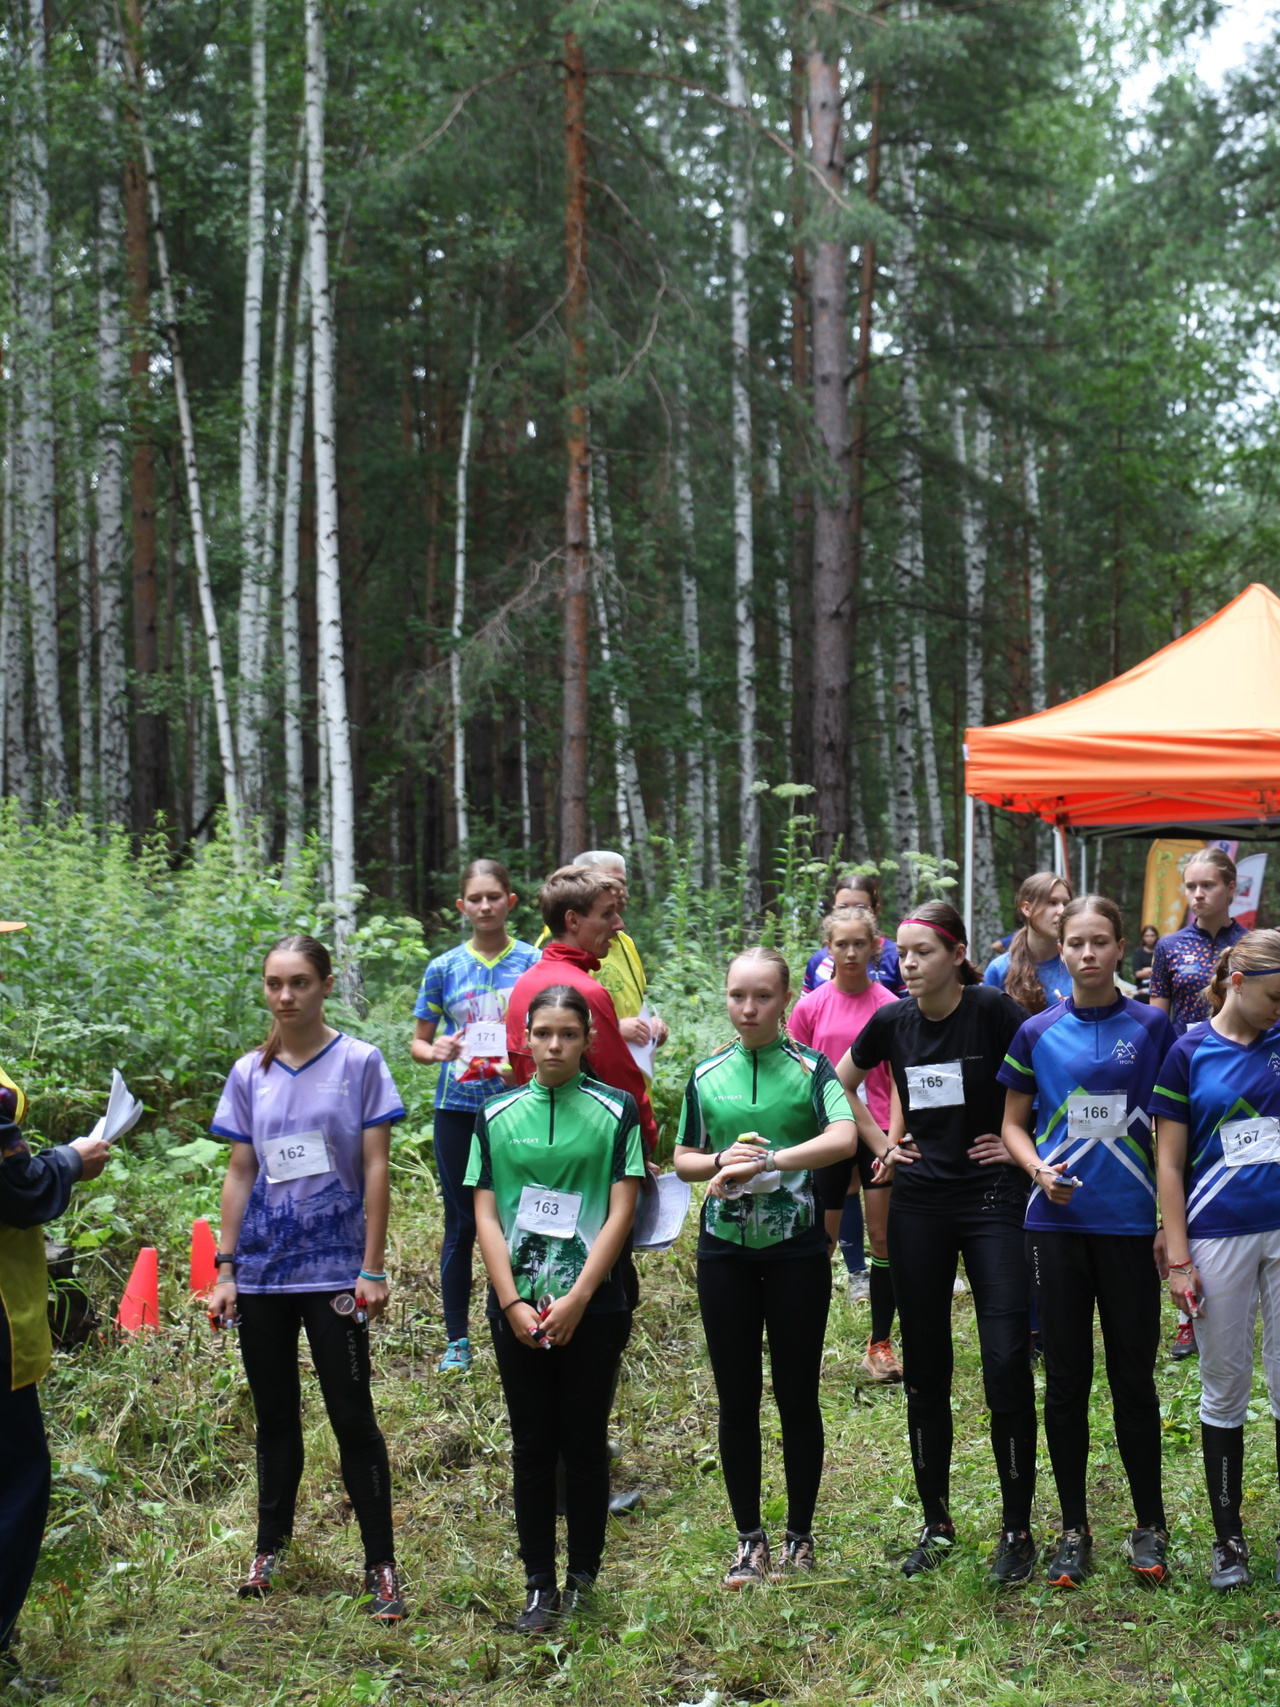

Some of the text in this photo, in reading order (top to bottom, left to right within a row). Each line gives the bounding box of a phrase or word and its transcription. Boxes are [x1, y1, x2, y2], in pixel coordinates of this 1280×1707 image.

[477, 1032, 496, 1042] 171
[920, 1075, 943, 1089] 165
[1082, 1106, 1109, 1119] 166
[1235, 1130, 1260, 1146] 167
[279, 1145, 306, 1161] 162
[534, 1200, 560, 1216] 163
